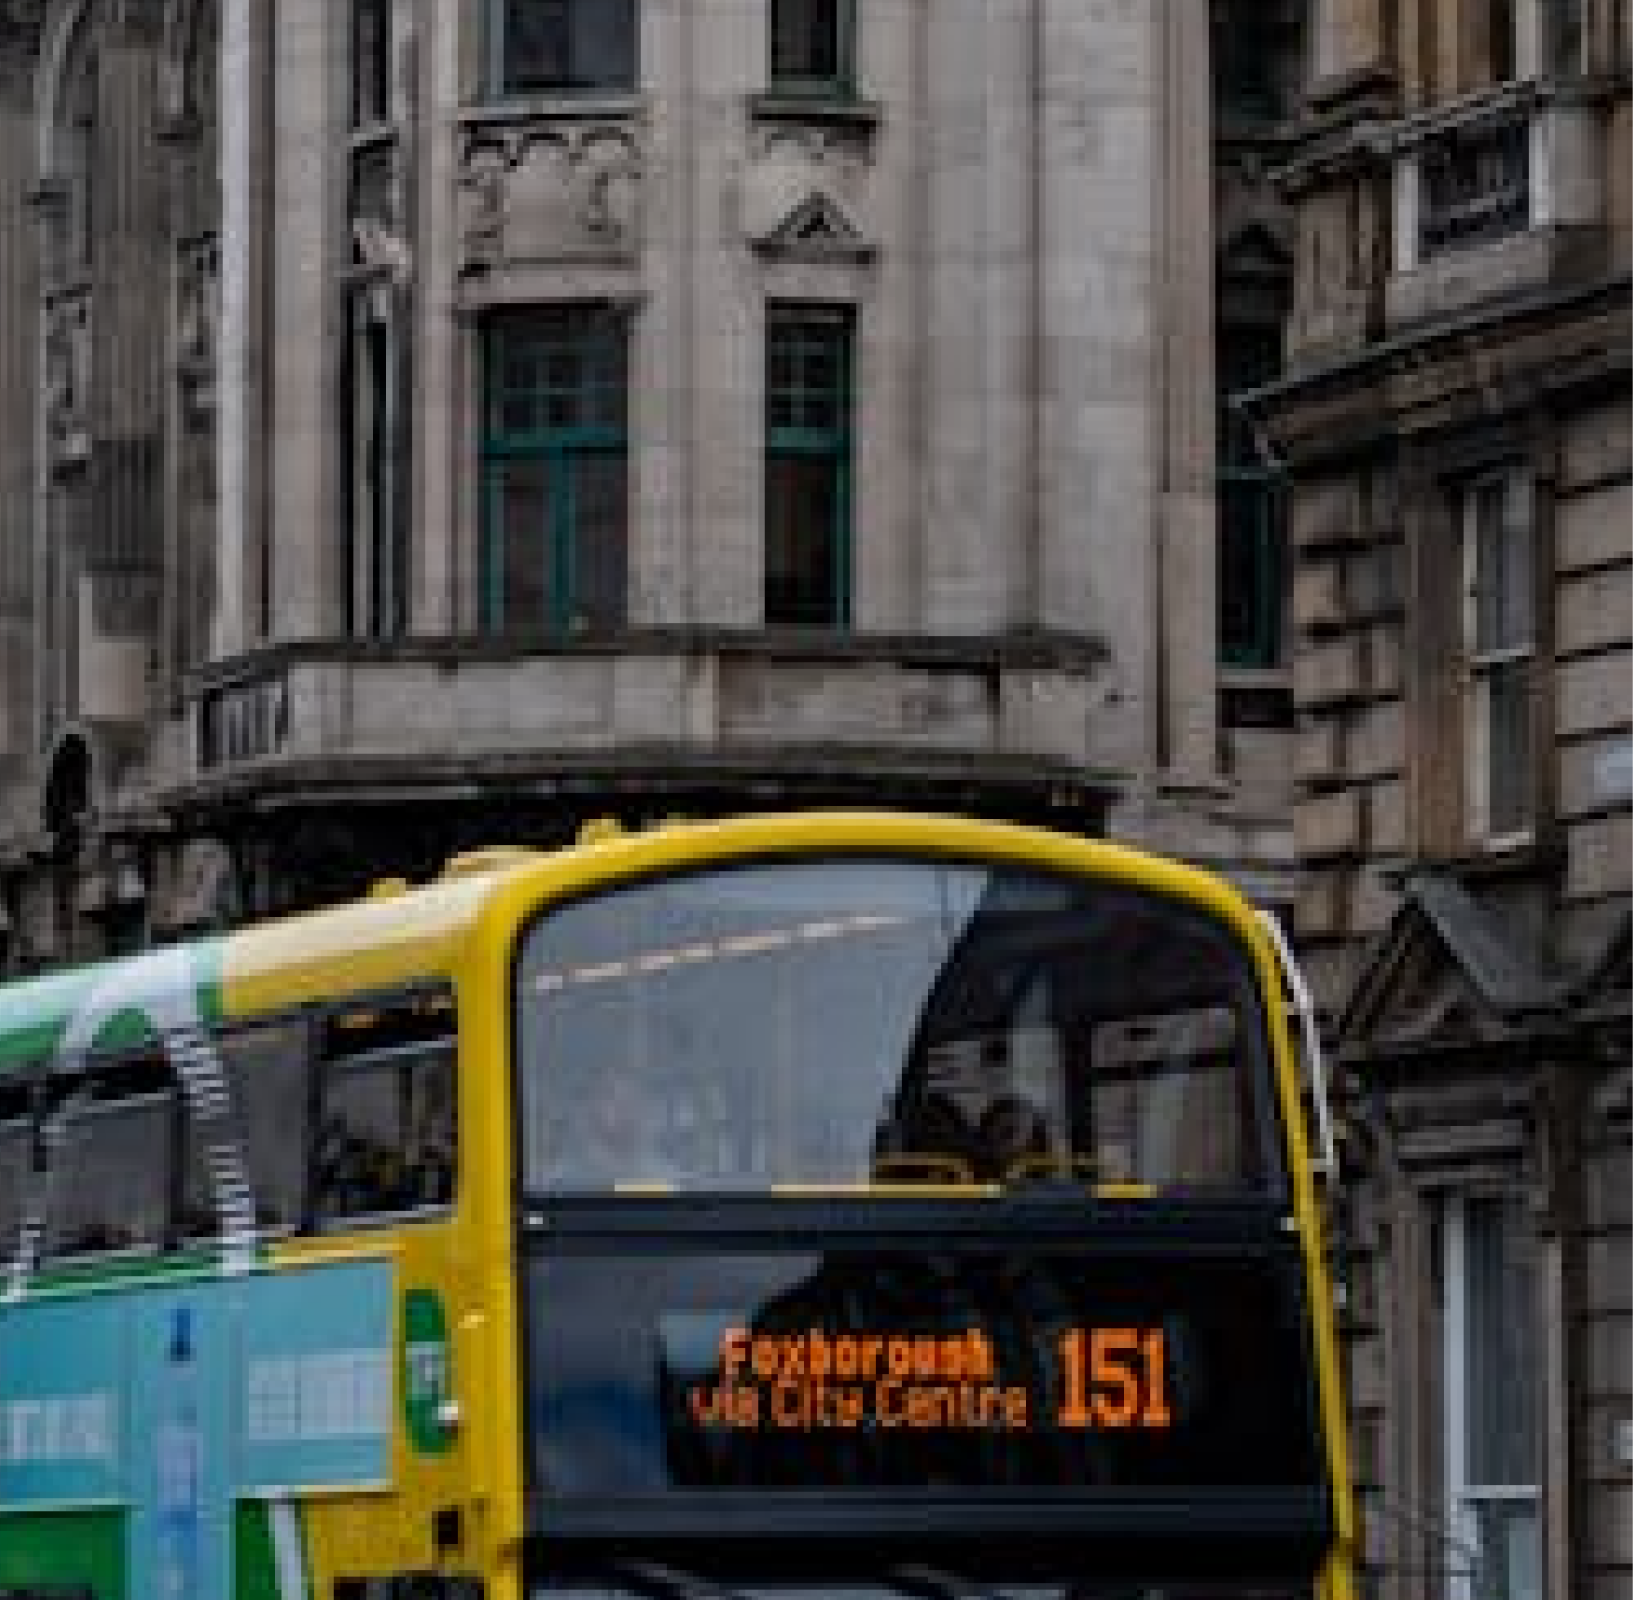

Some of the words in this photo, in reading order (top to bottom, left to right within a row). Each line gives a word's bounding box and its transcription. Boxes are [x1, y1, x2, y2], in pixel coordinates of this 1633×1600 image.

[718, 1326, 997, 1381] Foxborough
[1056, 1325, 1171, 1428] 151
[690, 1384, 761, 1428] via
[769, 1380, 865, 1428] City
[874, 1380, 1029, 1428] Centre
